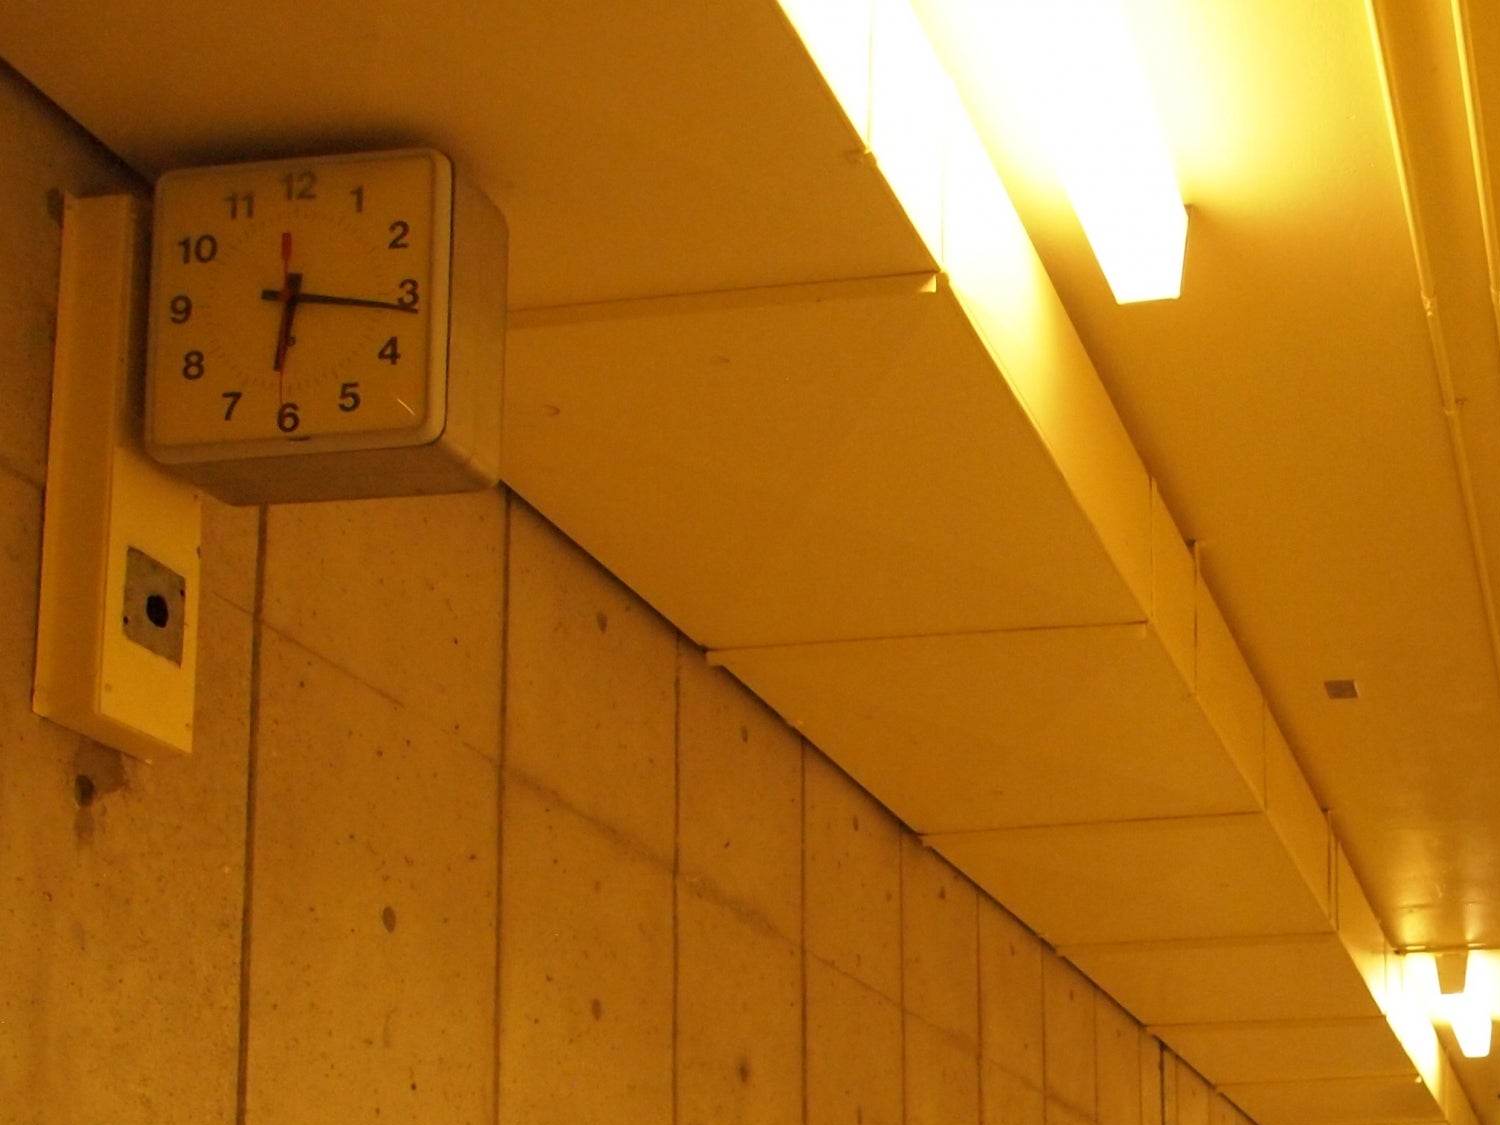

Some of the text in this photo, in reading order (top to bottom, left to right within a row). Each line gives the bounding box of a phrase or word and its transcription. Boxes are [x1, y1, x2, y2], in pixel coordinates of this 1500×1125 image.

[283, 172, 316, 200] 12
[351, 186, 364, 212] 1
[225, 191, 254, 219] 11
[178, 234, 217, 264] 10
[388, 221, 410, 249] 2
[398, 279, 419, 309] 3
[170, 295, 192, 324] 9
[182, 351, 204, 380] 8
[378, 337, 401, 365] 4
[221, 391, 242, 421] 7
[338, 382, 361, 412] 5
[277, 403, 299, 432] 6
